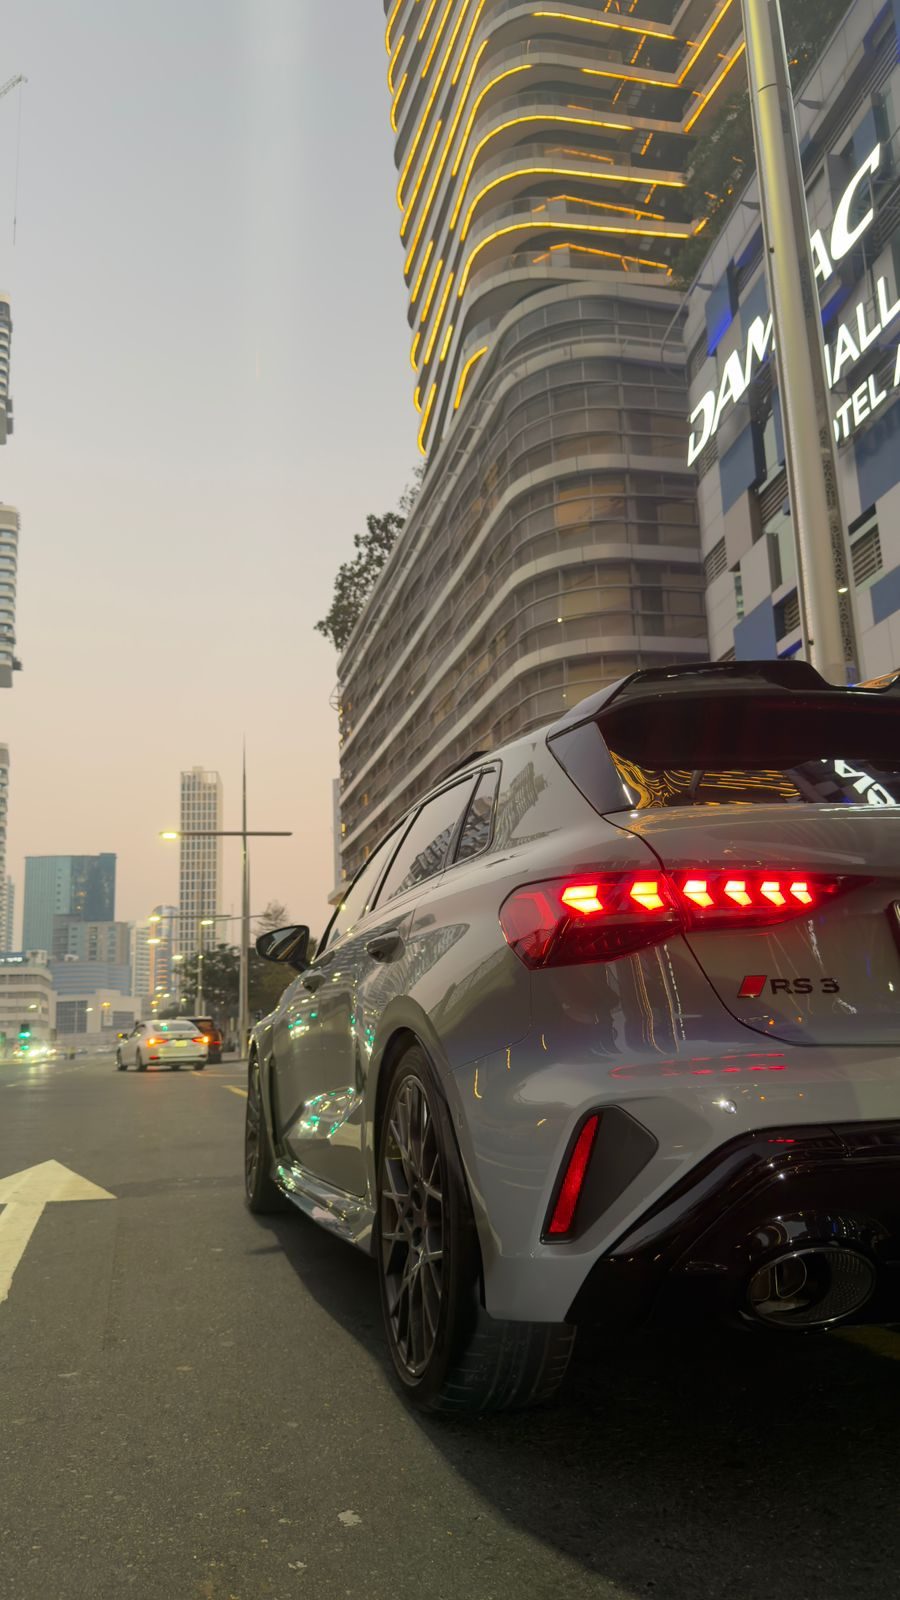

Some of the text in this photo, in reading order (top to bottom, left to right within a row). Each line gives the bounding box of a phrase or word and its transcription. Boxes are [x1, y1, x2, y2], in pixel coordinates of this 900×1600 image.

[824, 276, 900, 389] ALL
[769, 978, 840, 994] RS 3
